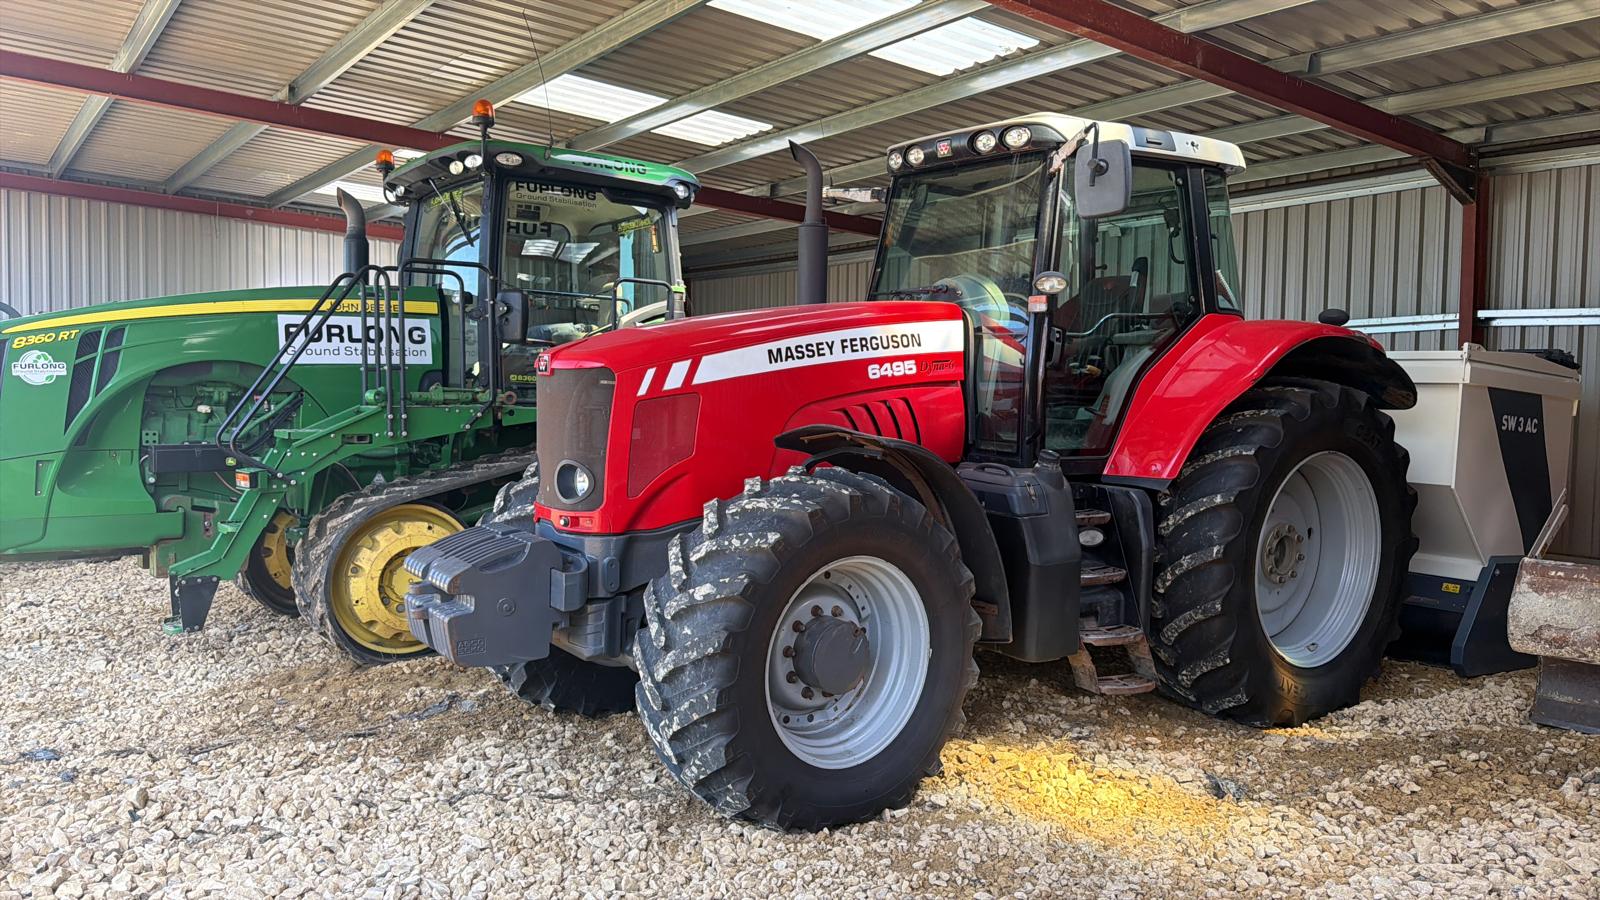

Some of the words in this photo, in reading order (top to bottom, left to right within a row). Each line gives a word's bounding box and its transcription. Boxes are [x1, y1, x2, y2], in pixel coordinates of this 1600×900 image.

[571, 155, 647, 175] LONG
[516, 192, 547, 201] Ground
[549, 195, 597, 208] Stabilisation
[362, 302, 399, 312] DEEE
[12, 333, 55, 349] 8360
[58, 330, 79, 341] RT
[767, 340, 835, 364] MASSEY
[840, 333, 922, 354] FERGUSON
[286, 345, 340, 356] Gound
[344, 345, 427, 357] Stblsaion
[868, 360, 917, 379] 6495
[1501, 414, 1518, 432] SW
[1518, 416, 1525, 433] 3
[1525, 417, 1539, 434] AC
